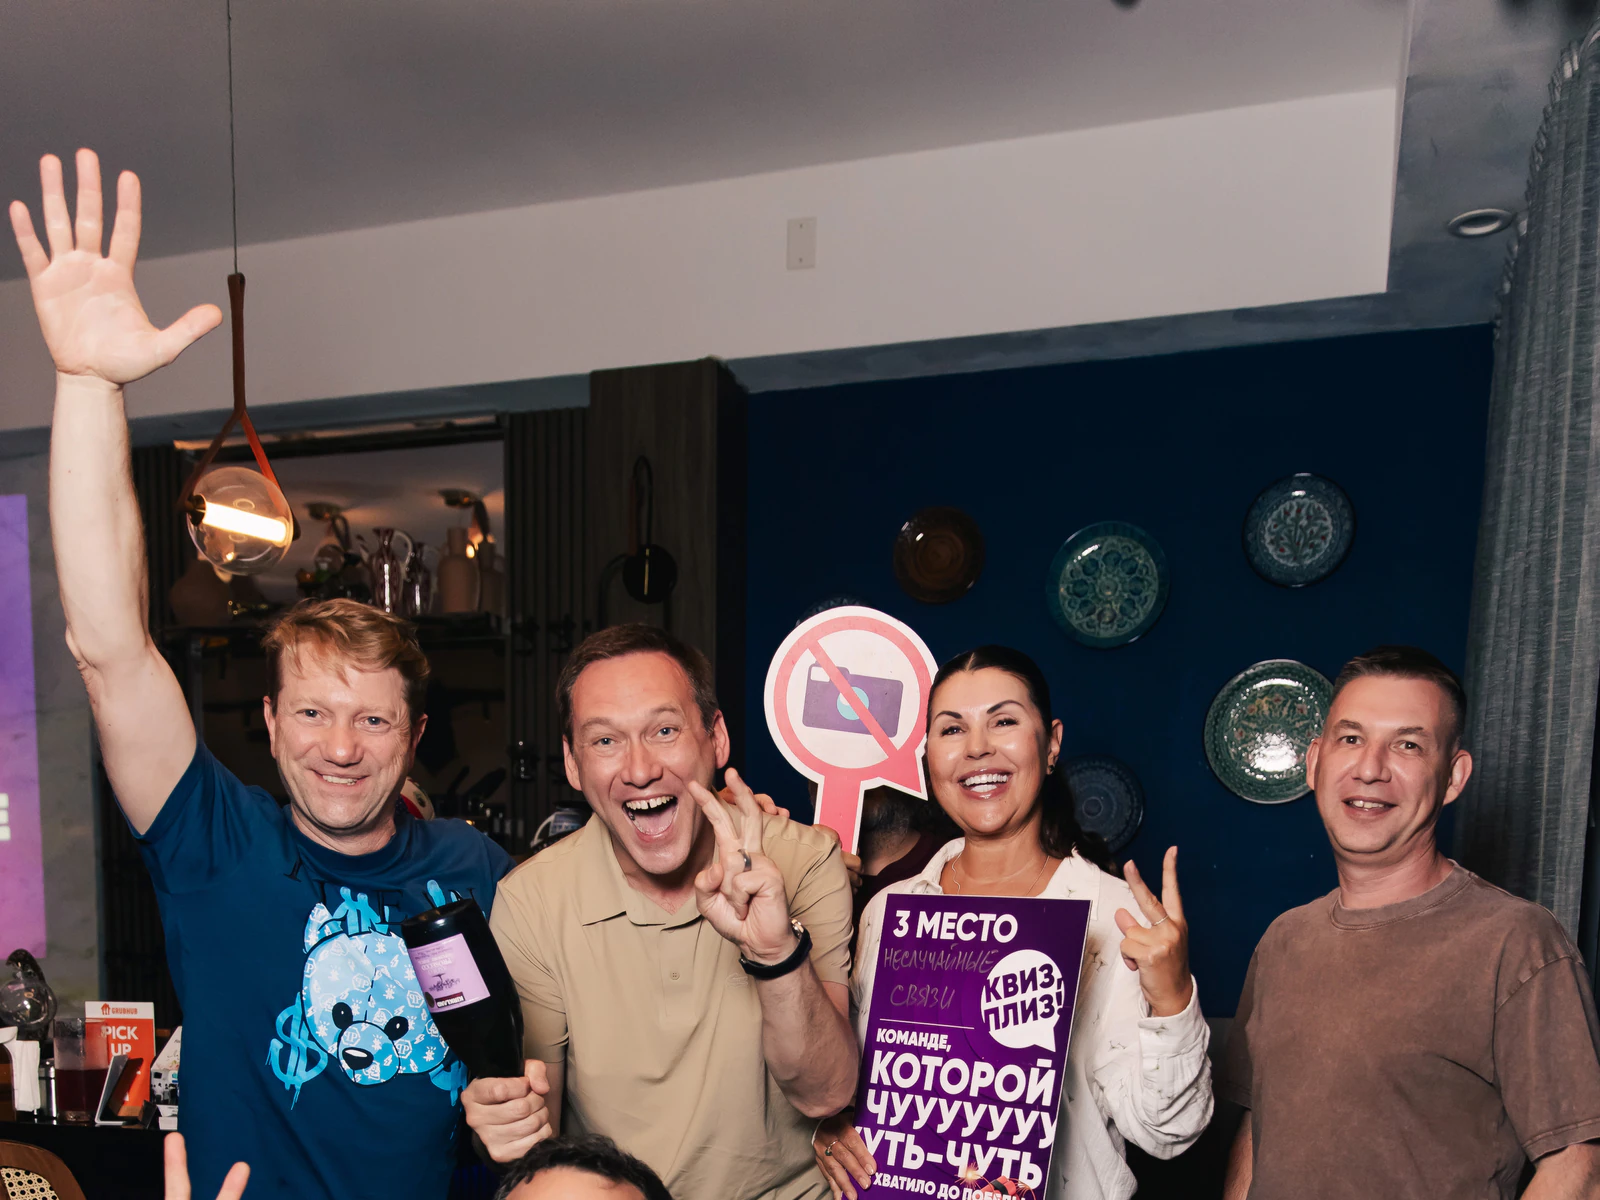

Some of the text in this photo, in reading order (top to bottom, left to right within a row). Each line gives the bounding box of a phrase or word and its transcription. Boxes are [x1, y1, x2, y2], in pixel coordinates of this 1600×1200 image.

[893, 910, 1019, 943] 3 МЕСТО
[884, 944, 998, 974] НЕСЛУЧАЙНЫЕ
[890, 984, 955, 1010] СВЯЗИ
[985, 963, 1063, 1003] КВИЗ,
[112, 1007, 138, 1015] GRUBHUB
[436, 995, 465, 1008] KIRKLAND
[984, 991, 1063, 1032] ПЛИЗ!
[103, 1026, 139, 1040] PICK
[876, 1028, 952, 1052] КОМАНДЕ,
[111, 1043, 132, 1057] UP
[870, 1050, 1056, 1107] КОТОРОЙ
[855, 1125, 1043, 1190] УТЬ-ЧУТЬ
[873, 1172, 936, 1196] ХВАТИЛО
[937, 1184, 960, 1200] ДО
